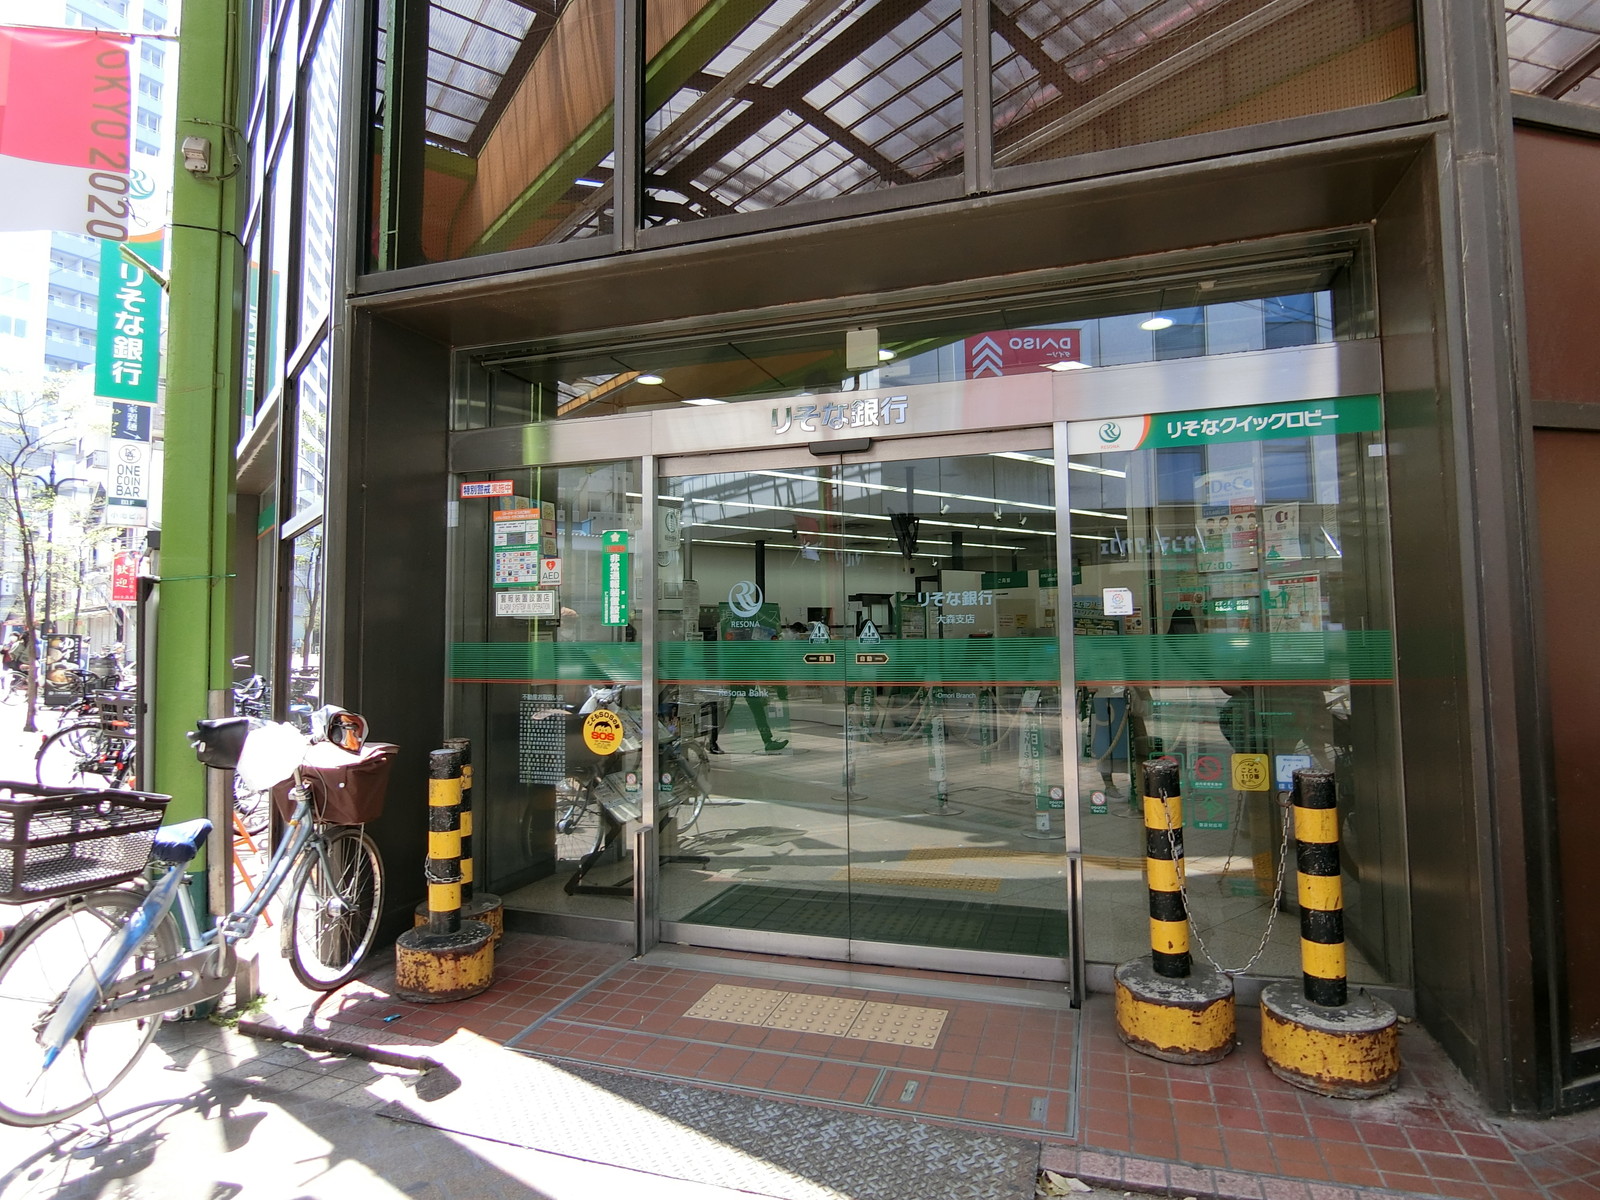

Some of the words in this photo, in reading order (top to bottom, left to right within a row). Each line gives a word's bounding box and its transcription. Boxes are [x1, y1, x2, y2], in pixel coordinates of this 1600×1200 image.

[86, 146, 130, 243] 2020
[113, 259, 146, 387] りそな銀行
[771, 395, 909, 435] りそな銀行
[1166, 408, 1340, 439] りそなクイックロビー
[117, 464, 141, 477] ONE
[116, 475, 141, 486] COIN
[116, 485, 140, 498] BAR
[542, 571, 560, 580] AED
[918, 590, 993, 607] りそな銀行
[731, 620, 761, 628] RESONA
[936, 614, 975, 624] 大森支店
[718, 688, 746, 698] Resona
[749, 687, 769, 698] Bank
[955, 691, 977, 699] Branch
[591, 731, 615, 741] SOS
